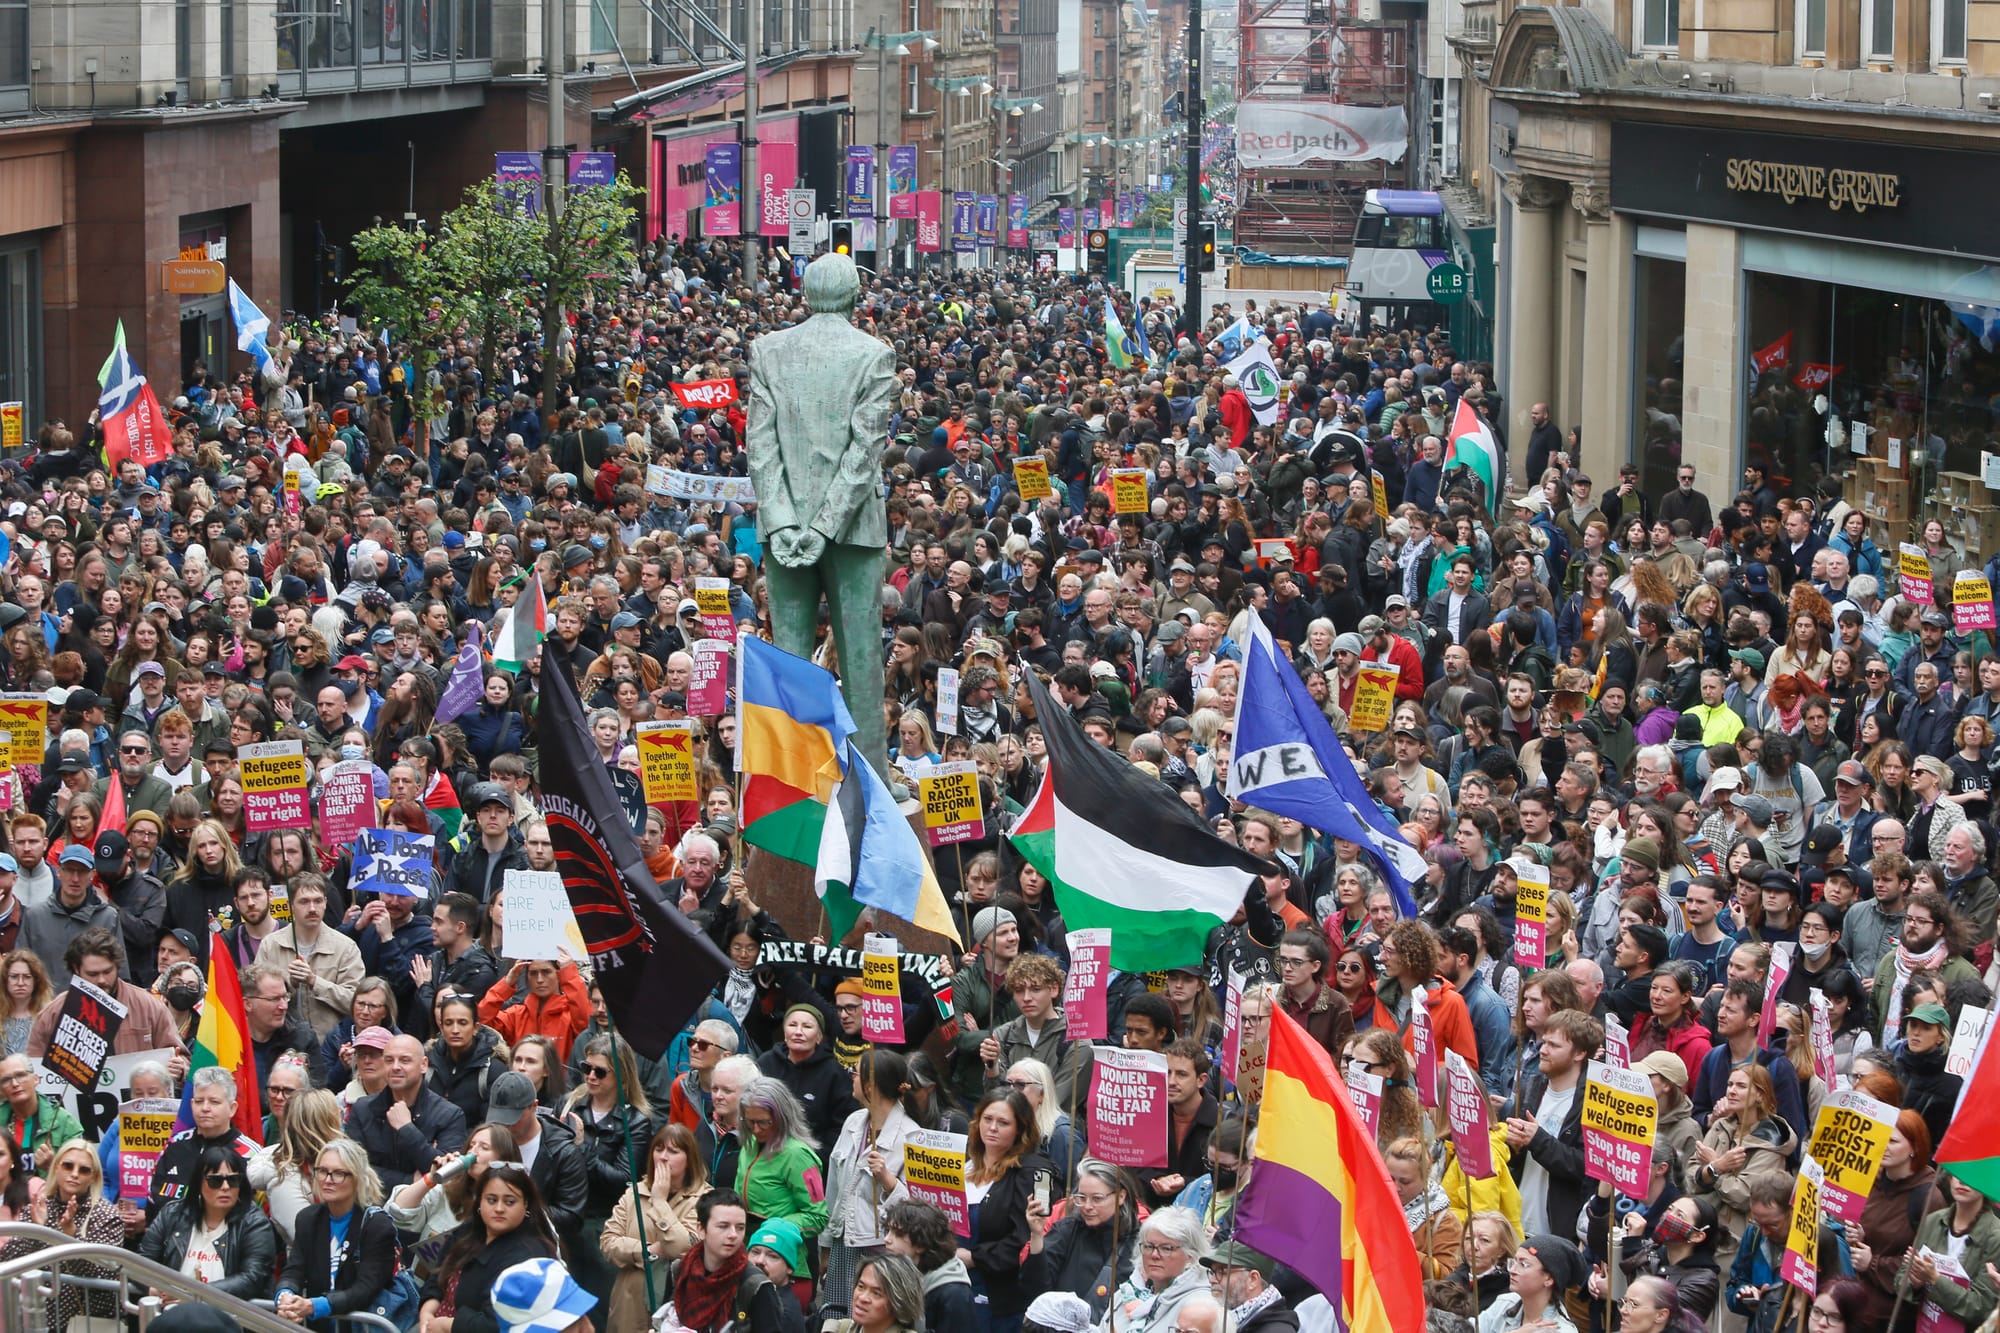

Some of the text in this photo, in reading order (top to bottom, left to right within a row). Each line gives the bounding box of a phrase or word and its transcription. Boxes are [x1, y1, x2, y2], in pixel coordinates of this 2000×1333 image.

[1240, 130, 1348, 153] Redpath
[1727, 158, 1899, 213] SØSTRENE GRENE
[764, 173, 773, 225] GLASGOW
[773, 196, 782, 225] MAKE
[1901, 564, 1930, 577] welcome
[1918, 579, 1929, 590] the
[1955, 581, 1988, 595] Refugees
[1912, 587, 1929, 600] right
[1955, 591, 1988, 601] welcome
[1956, 603, 1990, 615] Stop the
[718, 616, 730, 626] the
[1957, 612, 1991, 624] far right
[713, 627, 733, 641] right
[702, 670, 717, 680] FAR
[1358, 687, 1380, 698] Together
[1374, 698, 1387, 709] stop
[1372, 707, 1387, 717] right
[24, 729, 40, 739] stop
[23, 738, 40, 748] right
[645, 751, 677, 764] Together
[243, 760, 302, 774] Refugees
[647, 761, 689, 772] we can stop
[246, 774, 301, 788] welcome
[648, 771, 692, 783] the far right
[932, 775, 964, 790] STOP
[324, 784, 367, 798] AGAINST
[928, 785, 971, 802] RACIST
[247, 791, 301, 809] Stop the
[325, 795, 365, 807] THE FAR
[927, 797, 975, 814] REFORM
[249, 806, 302, 822] far right
[326, 804, 356, 817] RIGHT
[944, 810, 961, 823] UK
[937, 823, 972, 836] Refugees
[939, 832, 972, 843] welcome
[359, 834, 433, 860] Nae Room
[354, 858, 429, 887] for Racists
[506, 897, 535, 911] ARE
[1521, 923, 1539, 939] the
[756, 941, 808, 966] FREE
[1079, 974, 1096, 988] FAR
[872, 1000, 895, 1014] the
[866, 1015, 895, 1033] right
[60, 1014, 108, 1057] REFUGEES
[54, 1028, 102, 1072] WELCOME
[1117, 1053, 1136, 1061] STAND
[1100, 1064, 1148, 1085] WOMEN
[1614, 1071, 1633, 1082] STAND
[1097, 1080, 1157, 1100] AGAINST
[1618, 1080, 1645, 1093] RACISM
[1096, 1094, 1152, 1113] THE FAR
[1588, 1084, 1655, 1119] Refugees
[1851, 1095, 1878, 1110] STAND UP
[1095, 1108, 1136, 1126] RIGHT
[1460, 1107, 1479, 1124] FAR
[1856, 1104, 1878, 1118] RACISM
[123, 1116, 175, 1133] Refugee
[1587, 1107, 1648, 1138] welcome
[1832, 1110, 1873, 1133] STOP
[1585, 1129, 1641, 1165] Stop the
[1819, 1126, 1875, 1156] RACIST
[123, 1155, 155, 1170] Stop
[906, 1147, 962, 1170] Refugees
[1811, 1142, 1872, 1176] REFORM
[1588, 1148, 1639, 1185] far right
[1821, 1161, 1845, 1183] UK
[123, 1173, 145, 1186] far
[908, 1166, 961, 1186] welcome
[909, 1185, 962, 1207] Stop the
